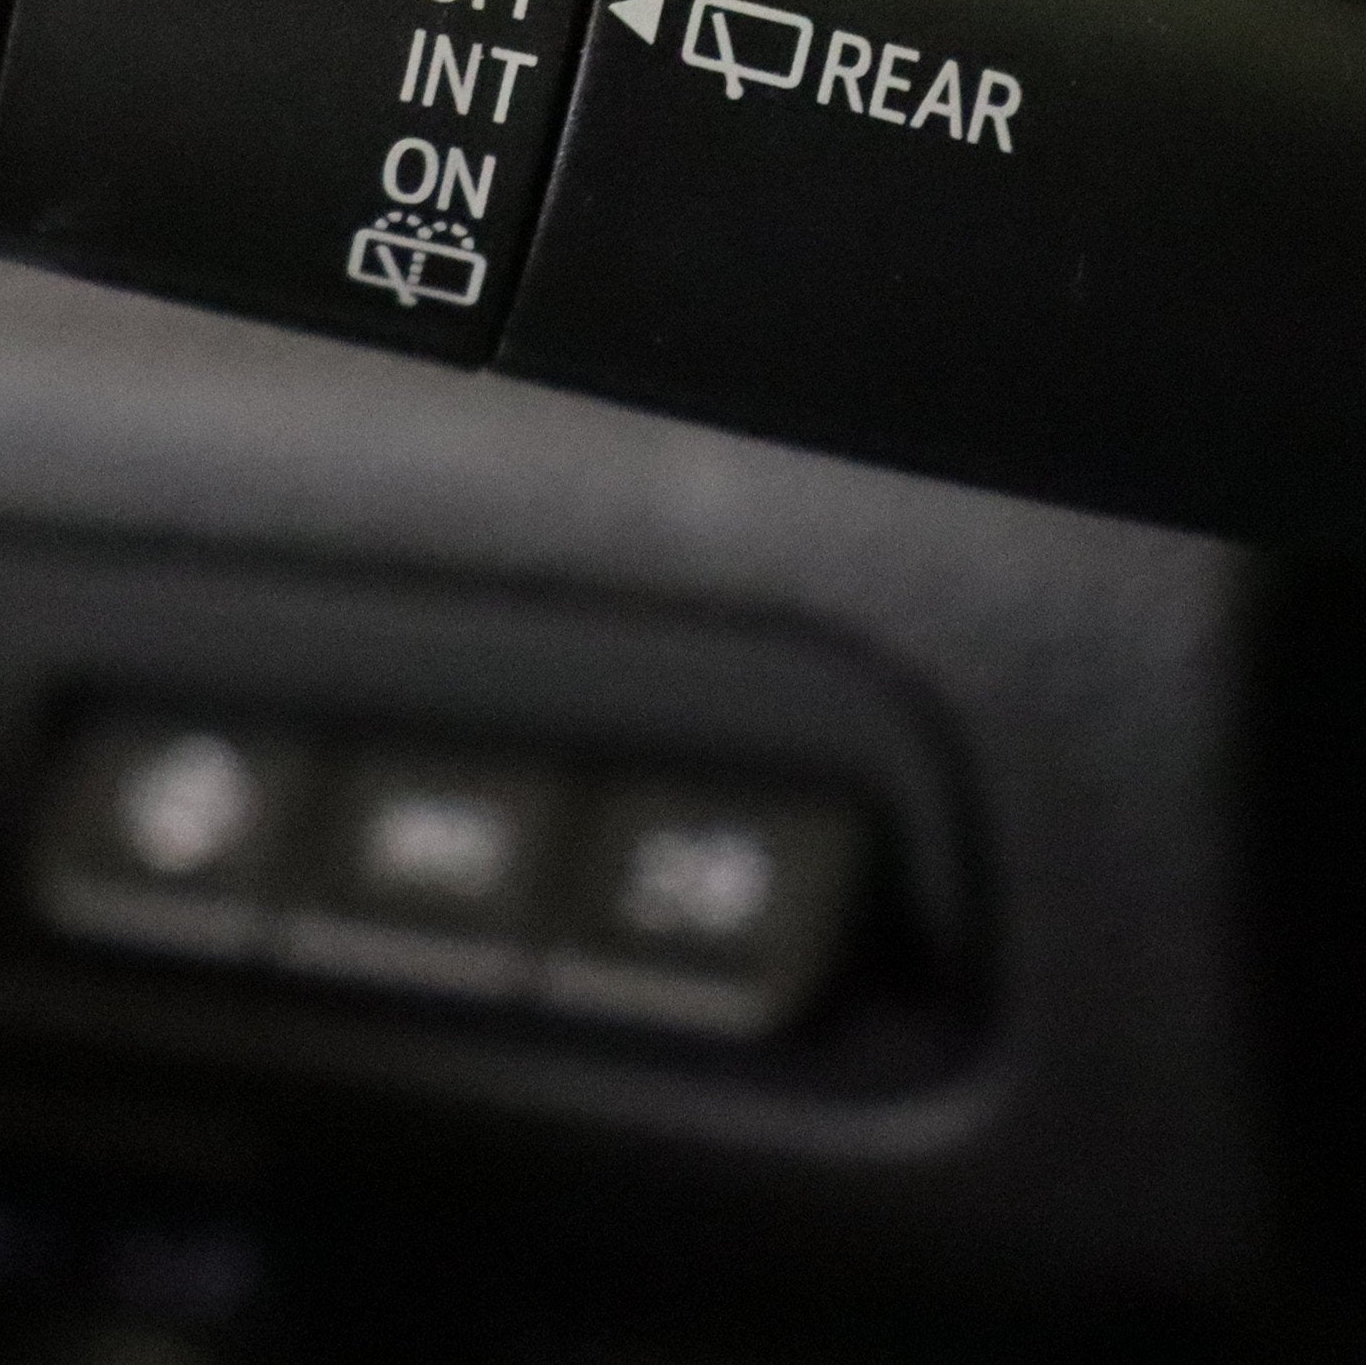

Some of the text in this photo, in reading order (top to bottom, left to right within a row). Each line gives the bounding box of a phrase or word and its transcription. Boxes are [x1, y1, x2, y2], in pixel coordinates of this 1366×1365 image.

[399, 28, 538, 124] INT
[816, 30, 1023, 153] REAR
[381, 137, 497, 220] ON
